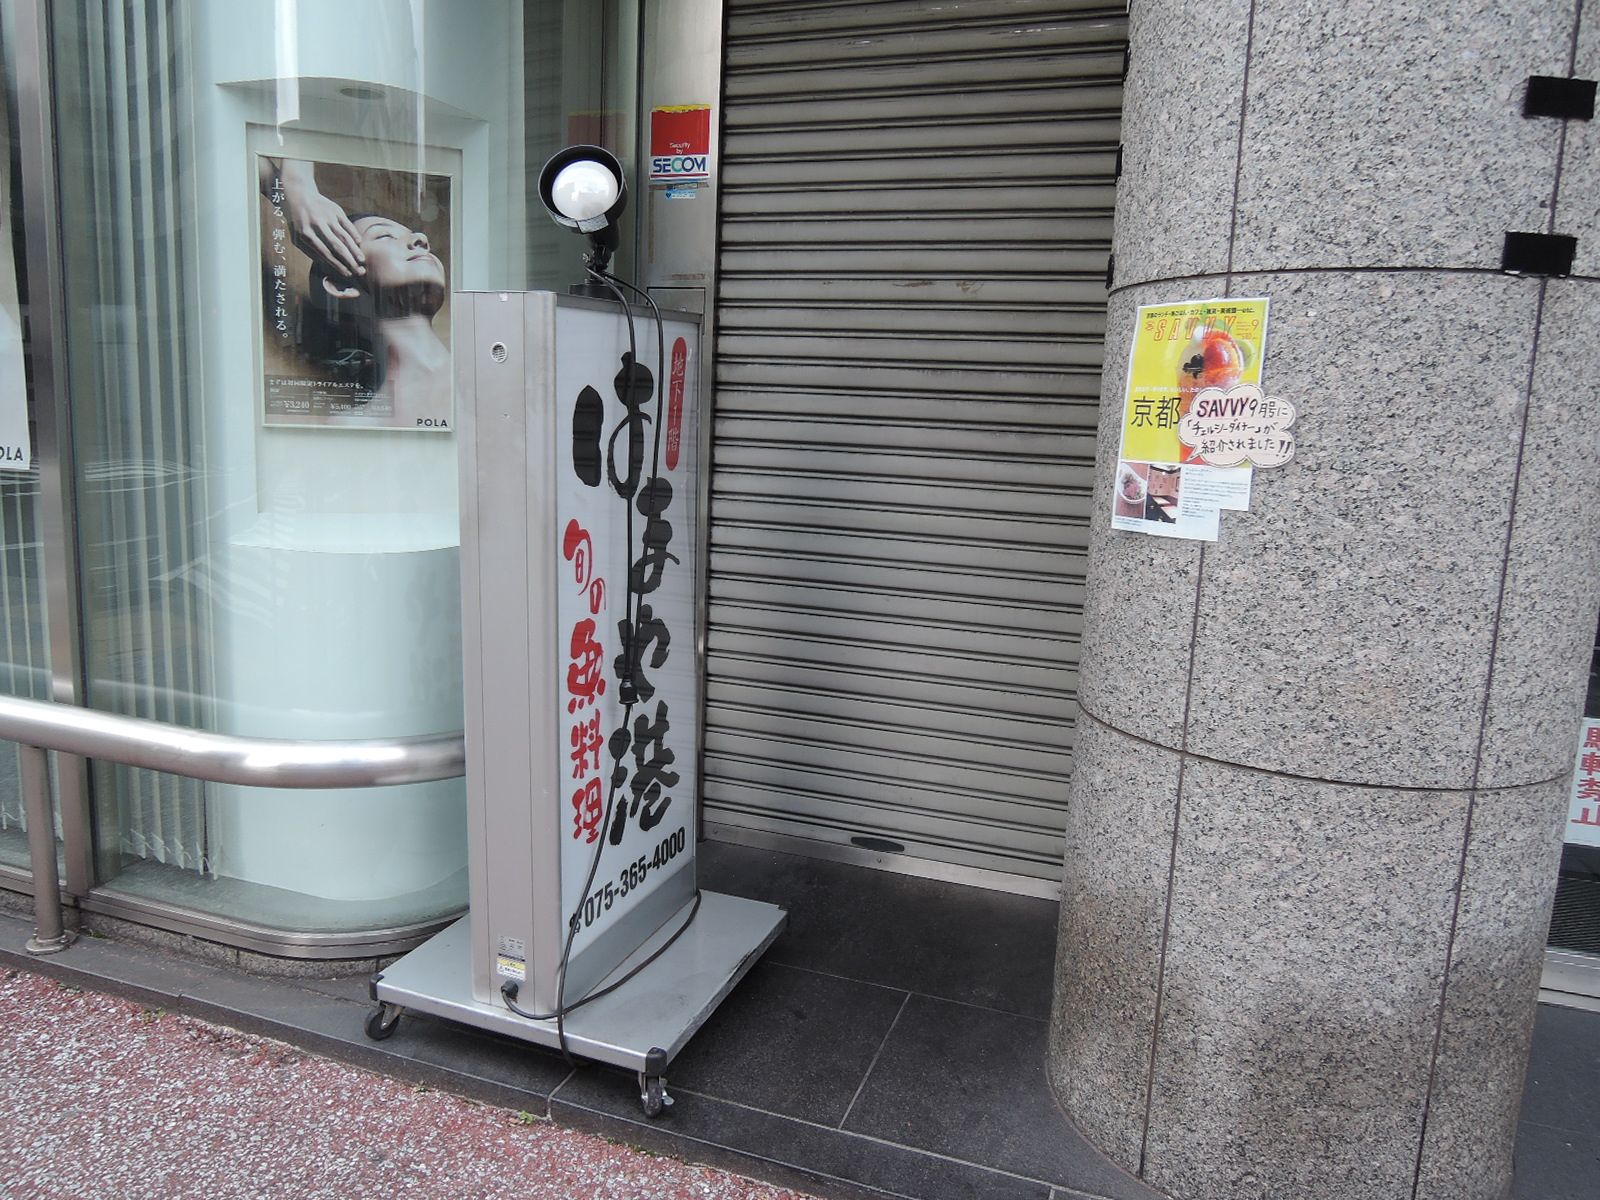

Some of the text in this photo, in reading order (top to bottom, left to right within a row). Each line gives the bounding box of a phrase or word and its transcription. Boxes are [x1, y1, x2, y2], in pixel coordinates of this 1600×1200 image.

[653, 157, 706, 173] SECOM
[271, 178, 289, 339] 上がる、弾む、満たされる。
[1154, 316, 1236, 342] SAVVY
[417, 418, 448, 428] POLA
[1131, 396, 1182, 429] 京都
[563, 518, 607, 844] 旬の魚料理
[585, 826, 685, 927] 075-365-4000
